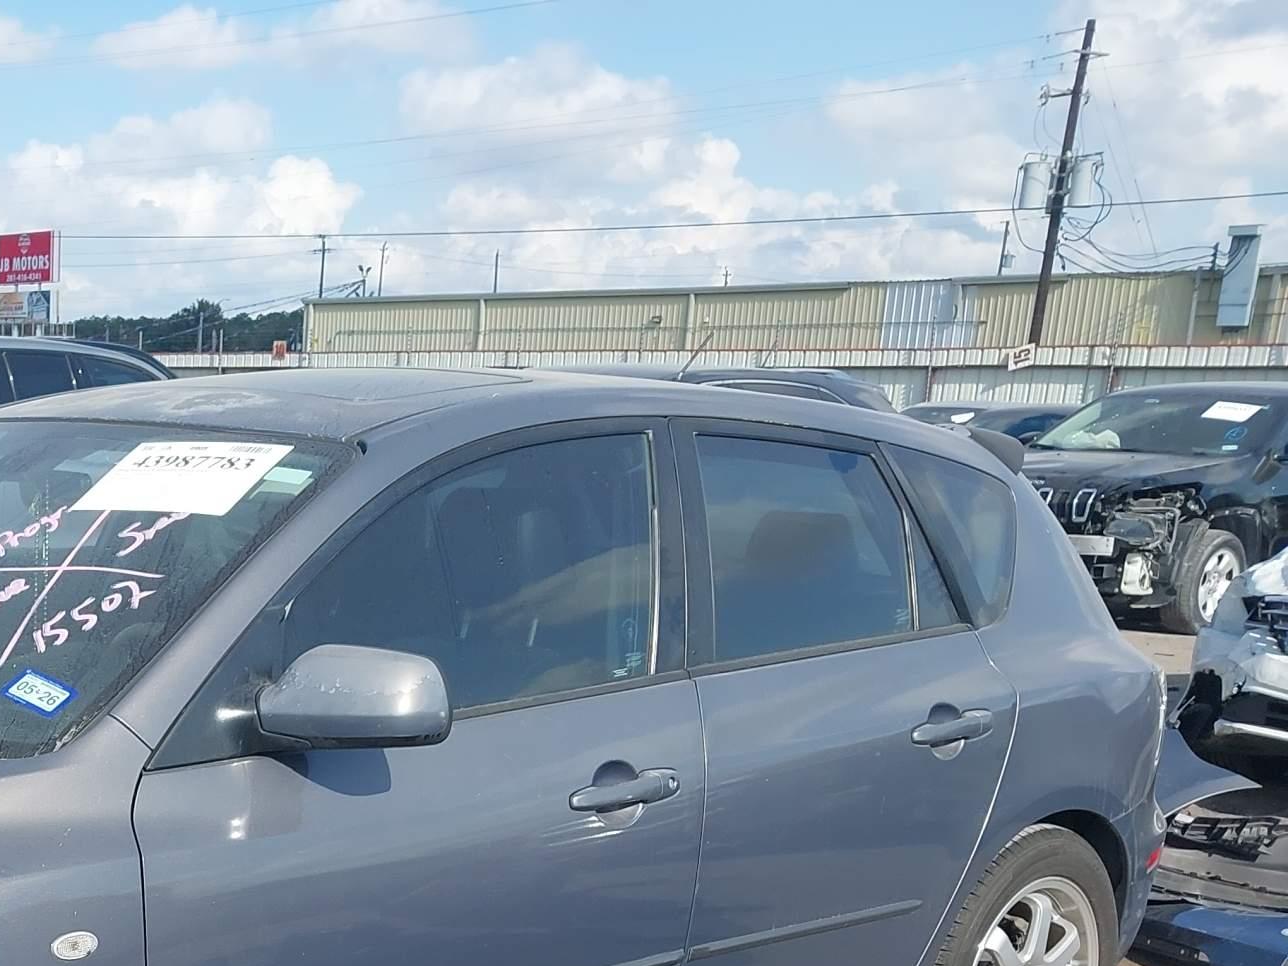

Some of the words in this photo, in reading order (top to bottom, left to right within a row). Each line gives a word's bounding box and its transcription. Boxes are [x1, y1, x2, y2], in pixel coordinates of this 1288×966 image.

[0, 256, 10, 272] JB
[12, 254, 49, 272] MOTORS
[132, 455, 256, 471] 43987783
